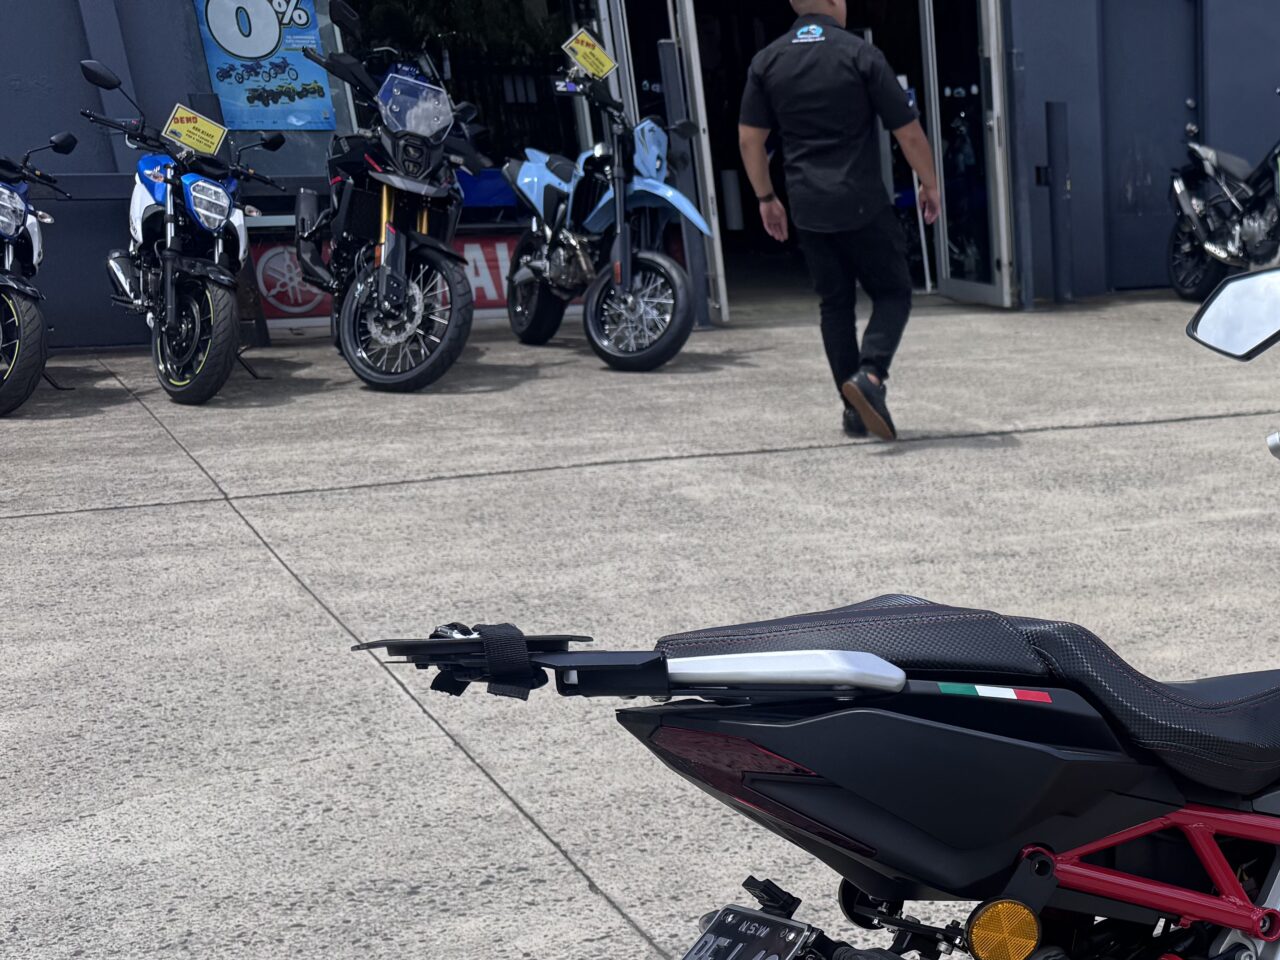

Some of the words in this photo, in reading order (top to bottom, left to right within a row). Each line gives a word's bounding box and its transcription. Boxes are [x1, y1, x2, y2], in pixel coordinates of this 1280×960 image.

[205, 0, 310, 60] 0%
[173, 116, 198, 124] DEMO
[738, 920, 770, 938] NSW
